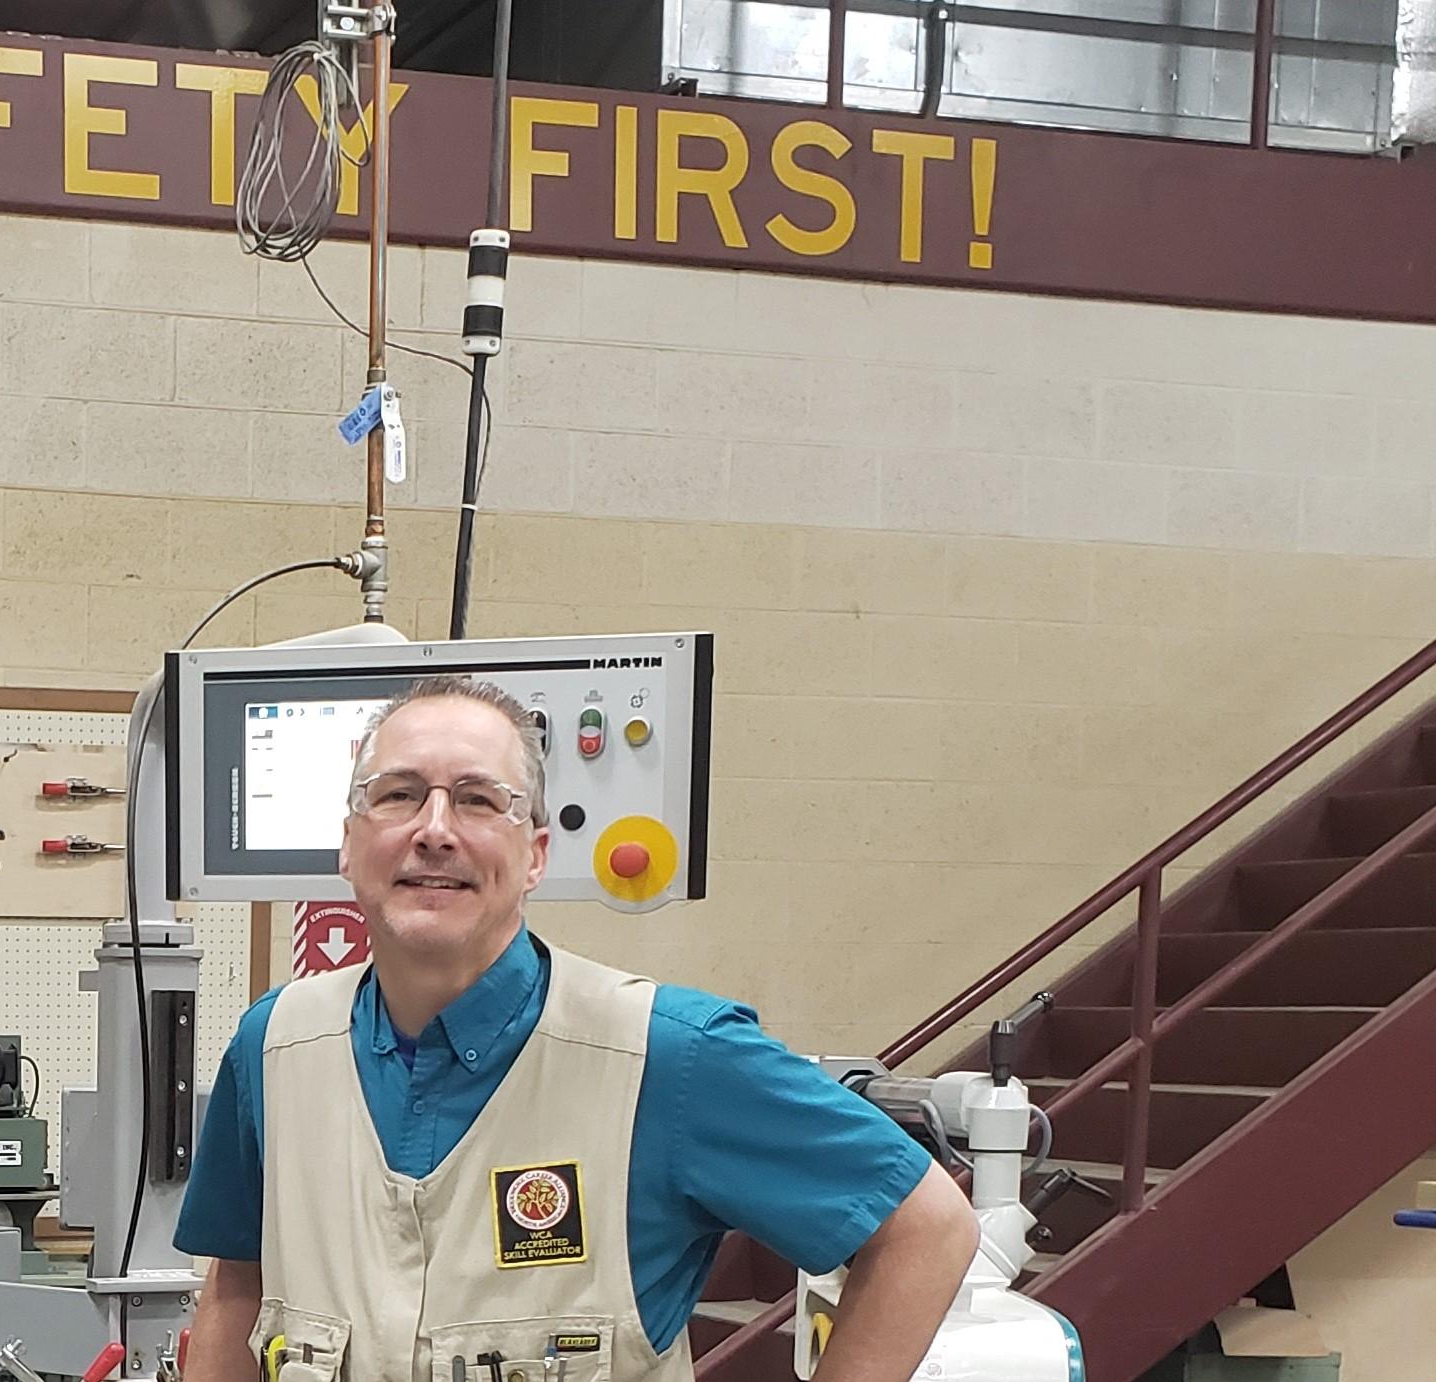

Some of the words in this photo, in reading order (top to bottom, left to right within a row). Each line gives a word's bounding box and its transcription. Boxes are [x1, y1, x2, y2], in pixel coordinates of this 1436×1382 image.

[509, 96, 997, 270] FIRST!
[593, 657, 662, 669] MARTIN
[309, 907, 365, 924] EXTINGUISHER
[529, 1231, 553, 1240] WCA
[514, 1238, 569, 1250] ACCREDITED
[504, 1251, 527, 1260] SKILL
